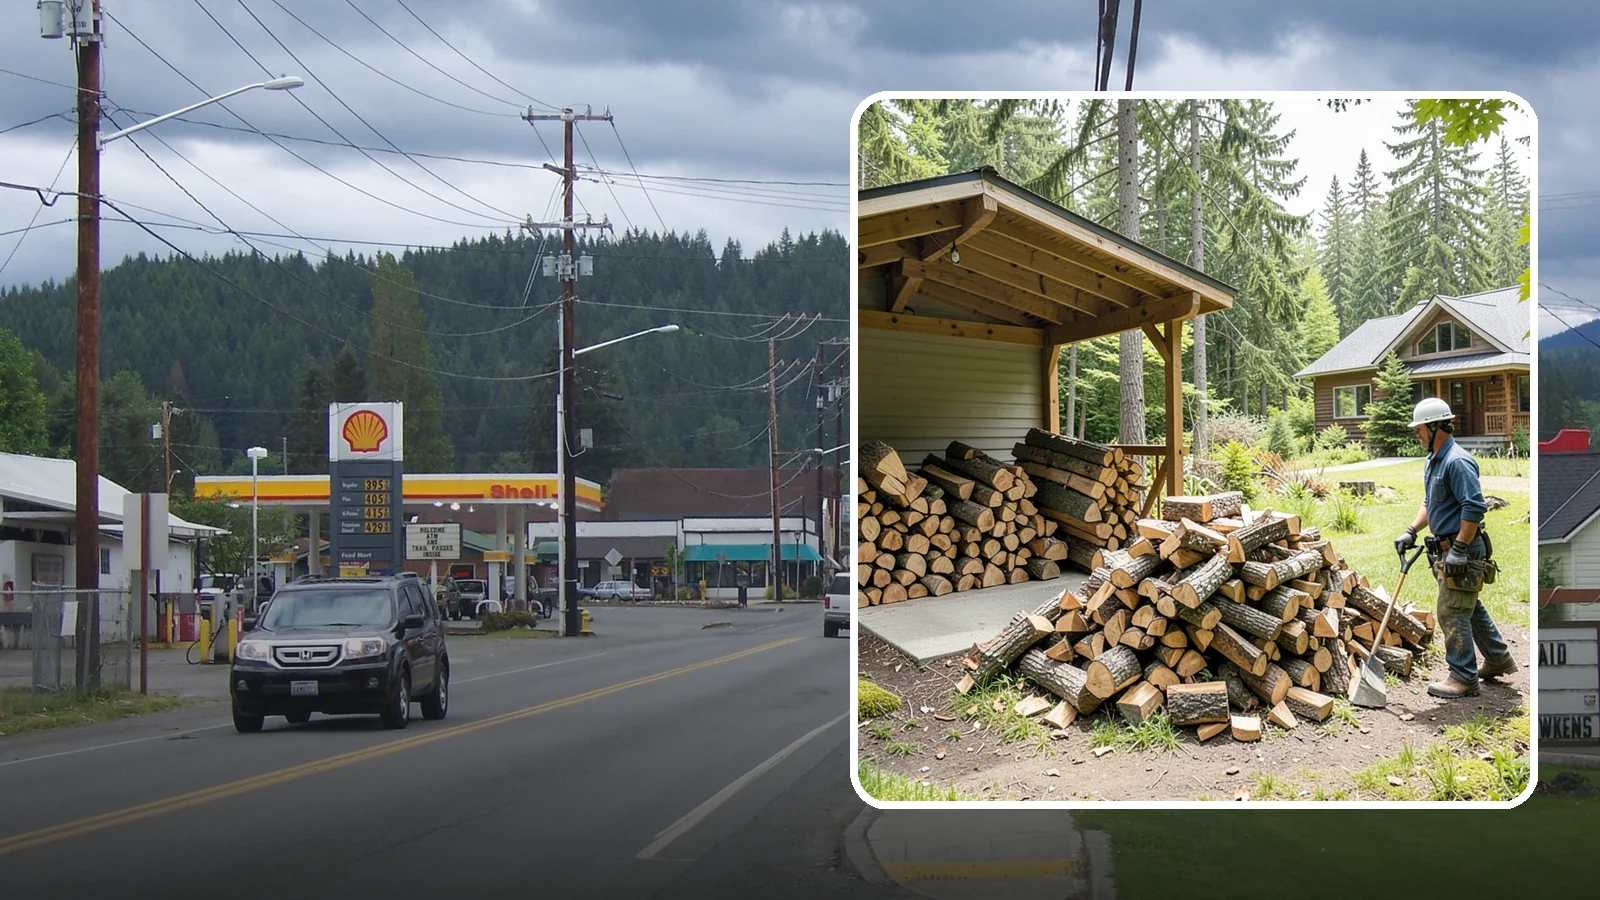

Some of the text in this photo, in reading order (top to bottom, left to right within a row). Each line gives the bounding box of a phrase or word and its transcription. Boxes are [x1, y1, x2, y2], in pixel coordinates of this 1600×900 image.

[365, 480, 383, 490] 395
[490, 484, 547, 499] Shell
[365, 494, 383, 504] 405
[365, 508, 383, 518] 415
[365, 522, 383, 533] 429
